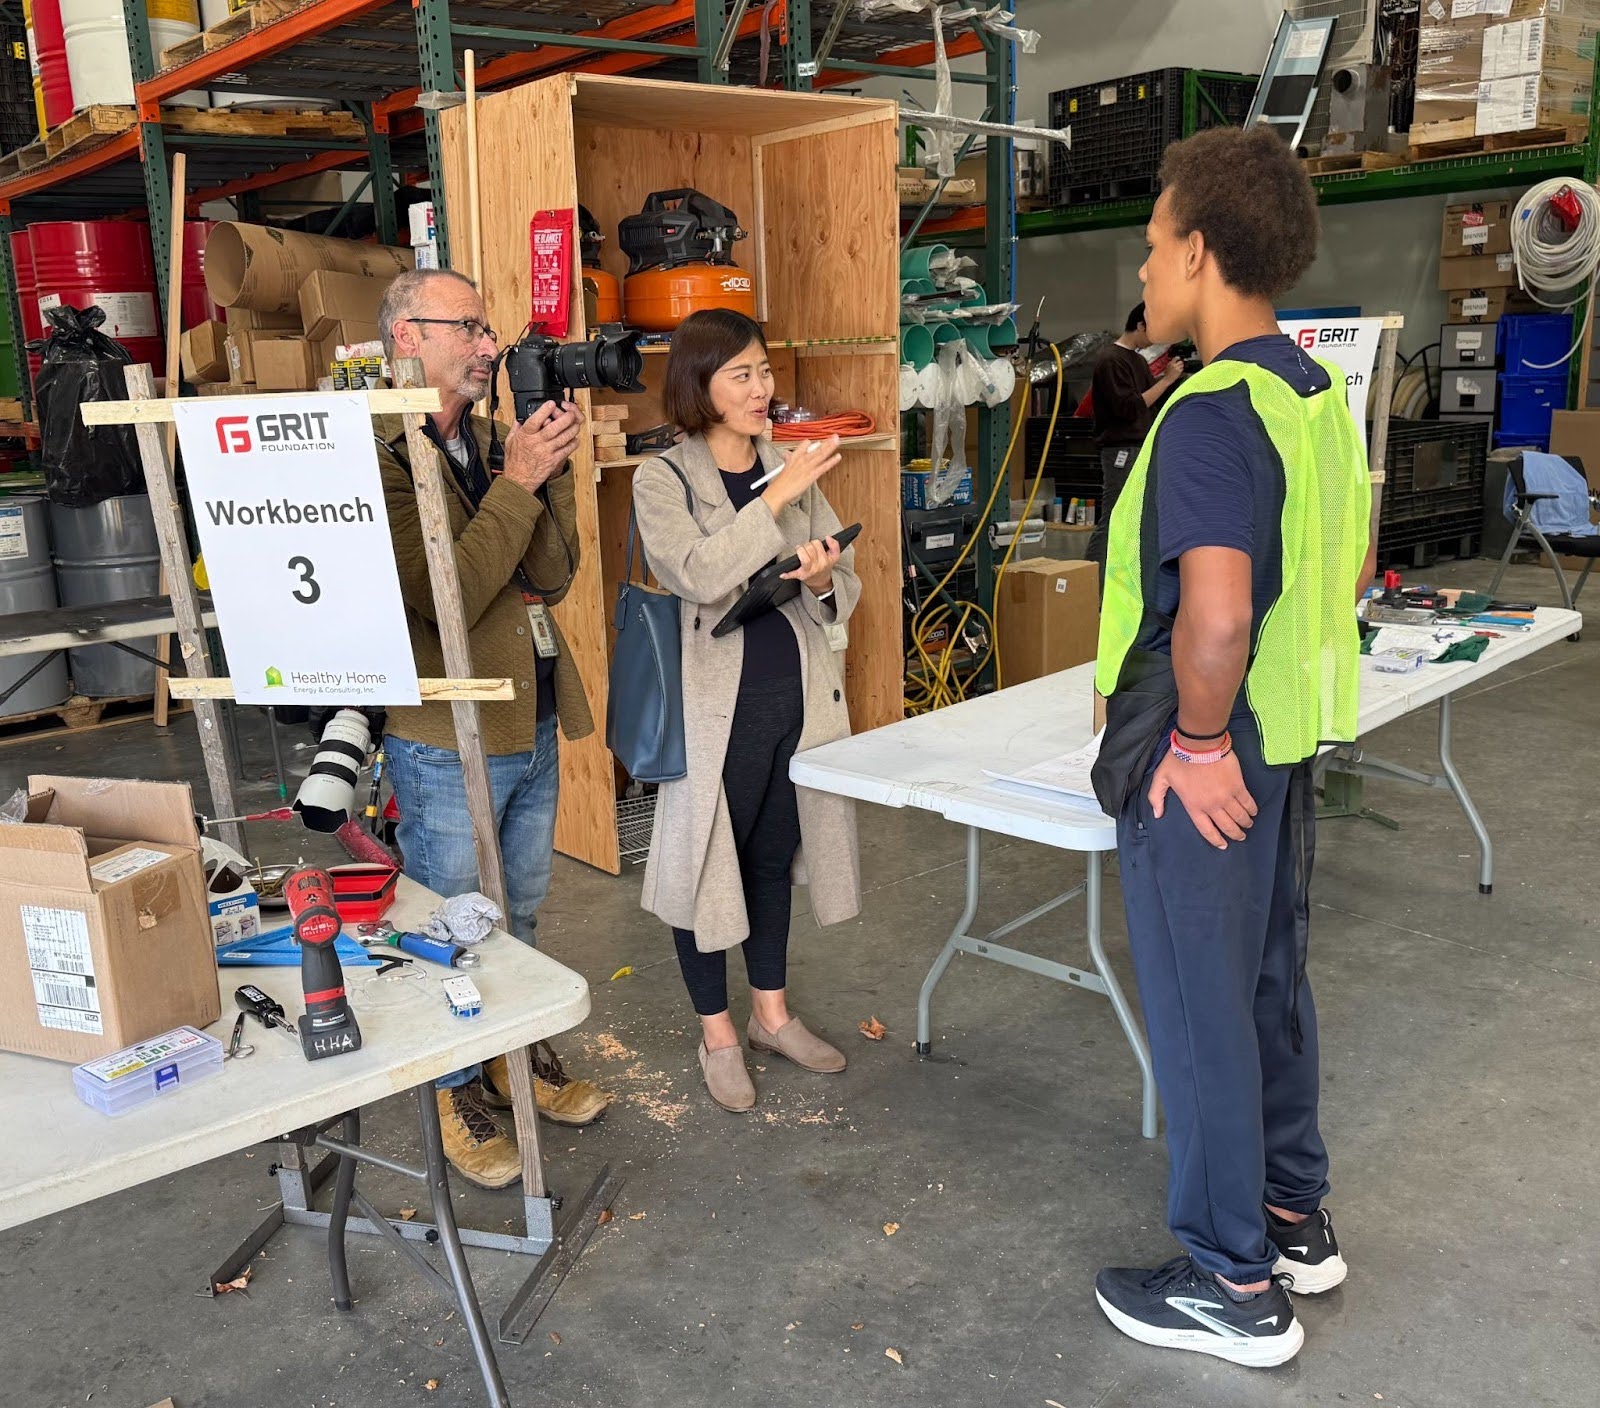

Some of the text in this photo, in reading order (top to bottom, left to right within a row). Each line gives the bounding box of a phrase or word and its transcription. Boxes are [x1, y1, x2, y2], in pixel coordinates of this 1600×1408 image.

[1463, 231, 1487, 240] BRENNER
[1463, 303, 1487, 312] BRENNER
[1319, 328, 1359, 342] GRIT
[255, 412, 329, 442] GRIT
[261, 442, 335, 452] FOUNDATION
[205, 497, 374, 526] Workbench
[287, 555, 321, 604] 3
[291, 671, 387, 686] Healthy Home
[324, 686, 362, 694] Consulting,
[302, 923, 334, 933] FUEL
[314, 1034, 354, 1054] HHA
